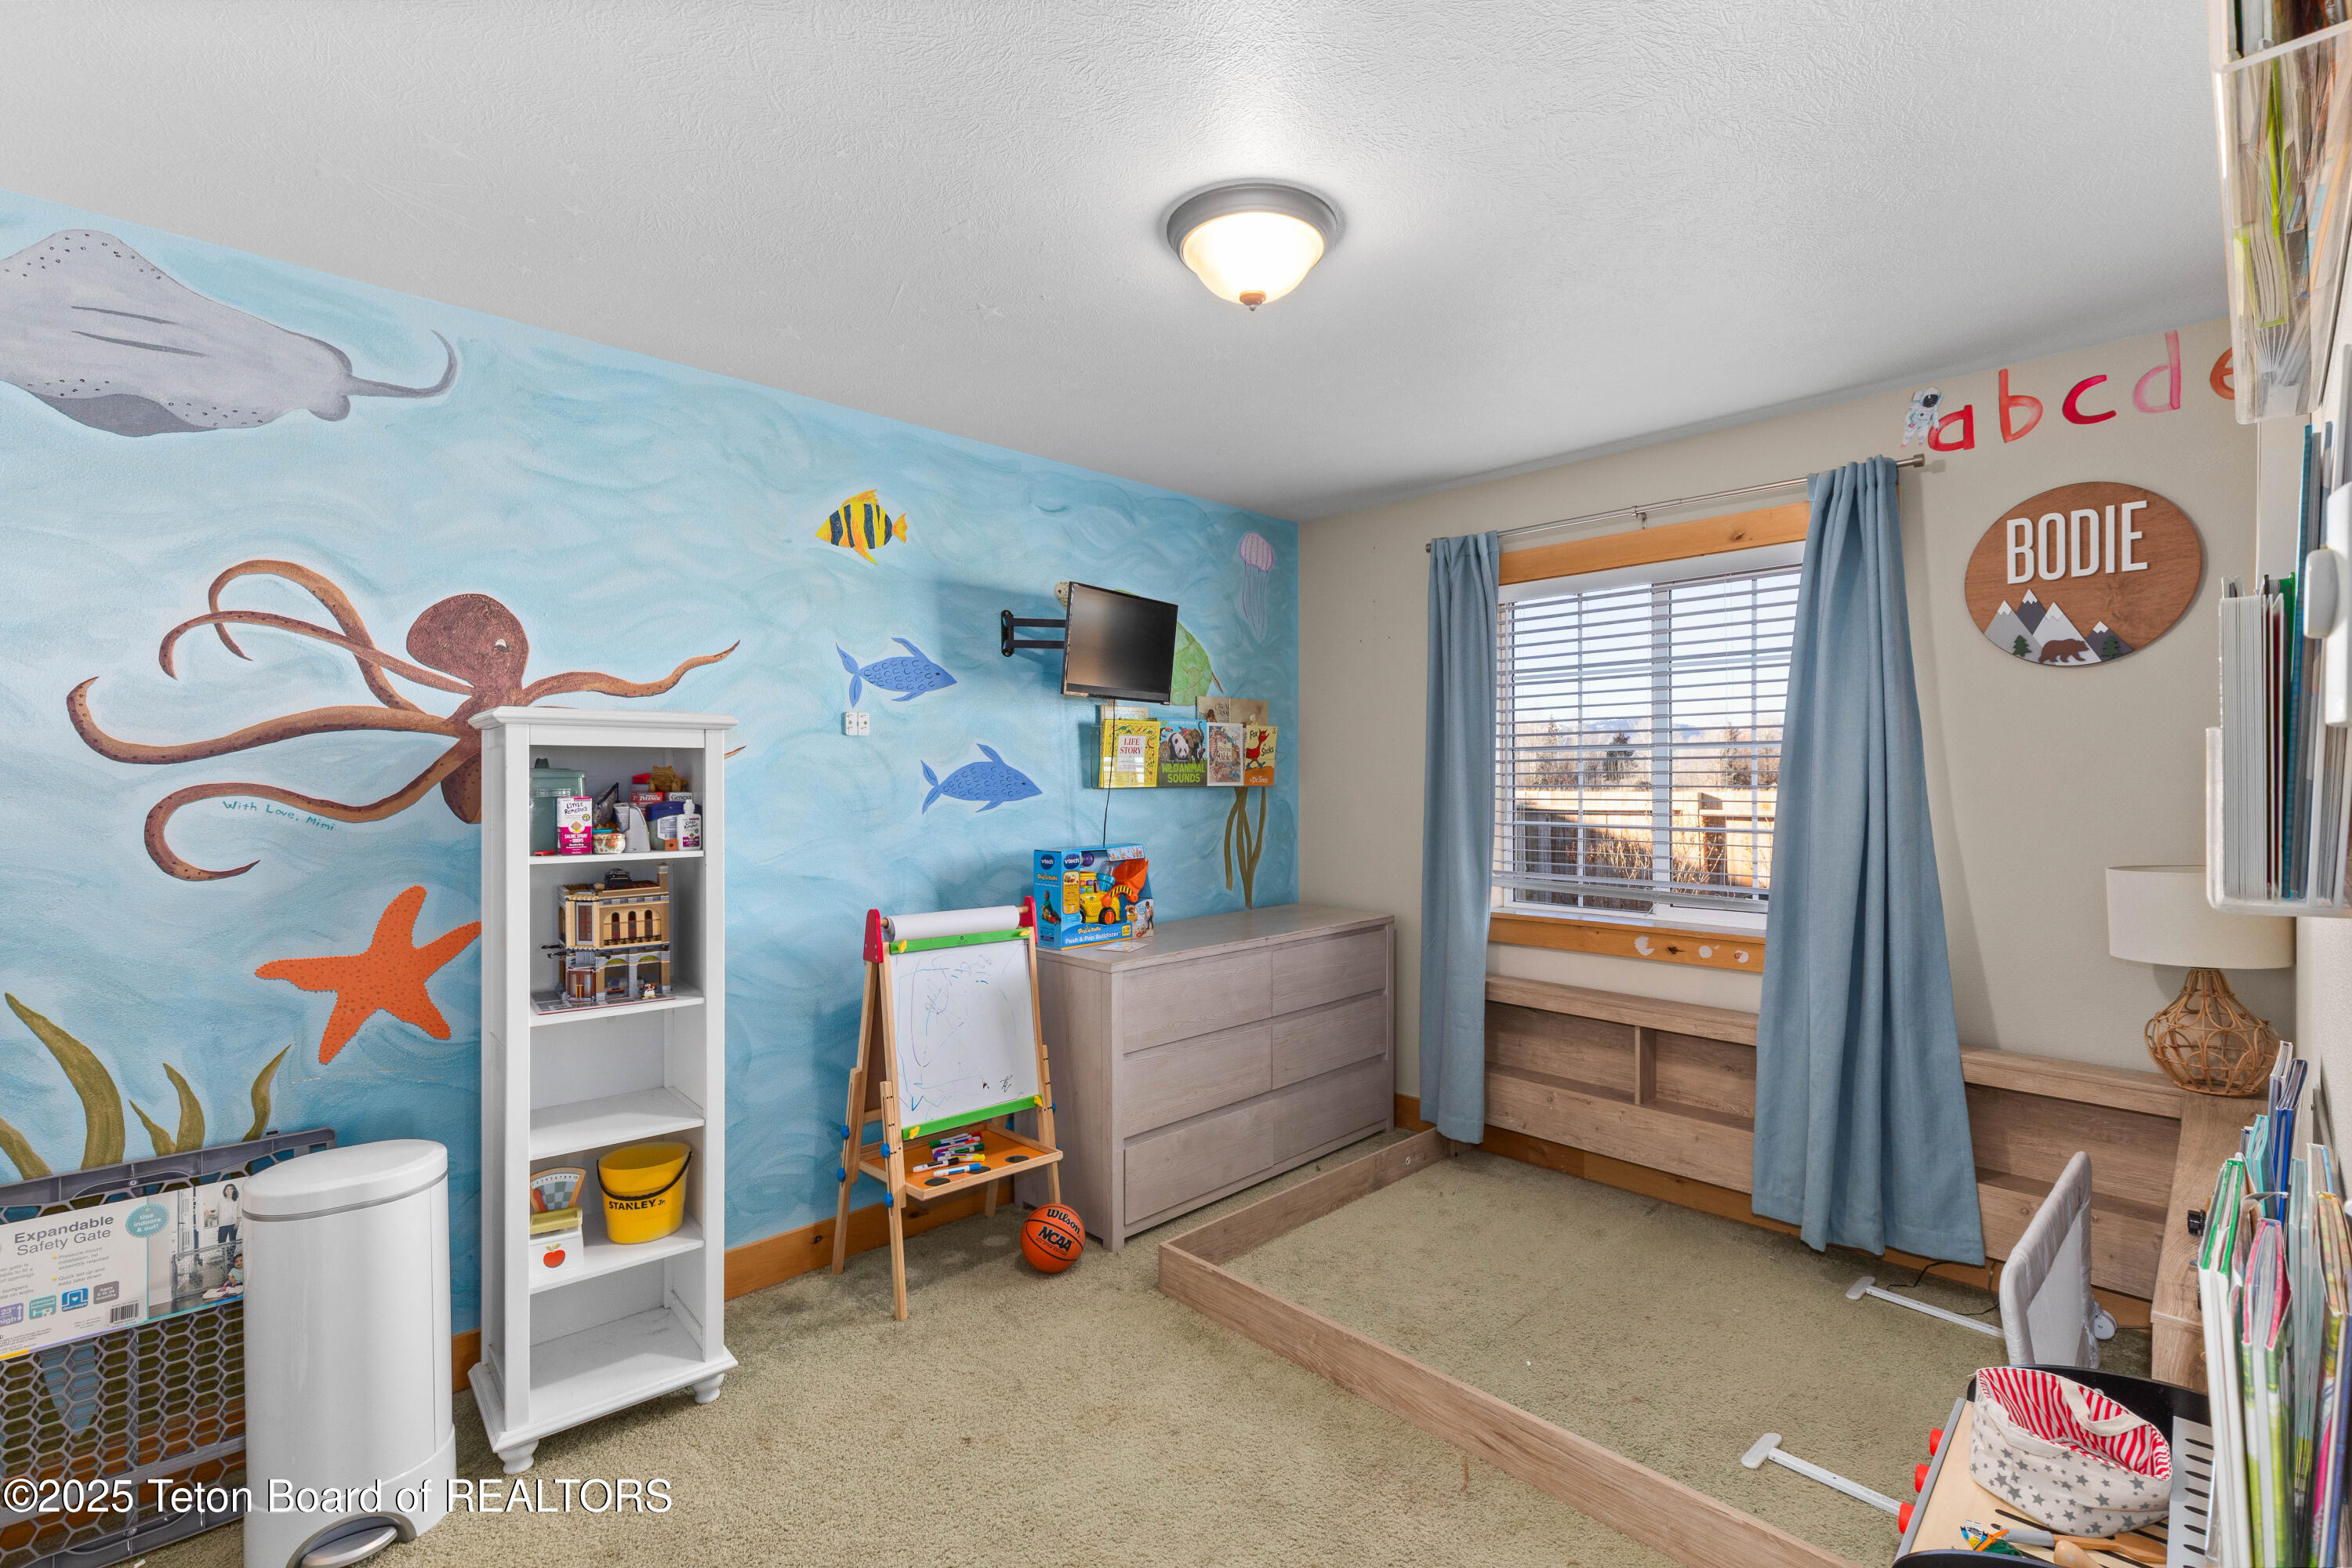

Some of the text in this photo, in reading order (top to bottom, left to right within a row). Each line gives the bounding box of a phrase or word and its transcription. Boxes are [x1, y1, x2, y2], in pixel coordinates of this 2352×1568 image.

[2005, 499, 2148, 586] BODIE
[1261, 746, 1274, 757] Socks
[1162, 763, 1205, 773] WILD ANIMAL
[1167, 773, 1201, 783] SOUNDS
[223, 800, 257, 811] With
[306, 816, 336, 831] Mimi
[608, 1199, 656, 1210] STANLEY
[14, 1216, 114, 1244] Expandable
[133, 1218, 162, 1227] indoors
[1047, 1208, 1080, 1235] Wilson
[16, 1229, 111, 1256] Safety Gate
[1037, 1225, 1073, 1252] NCAA
